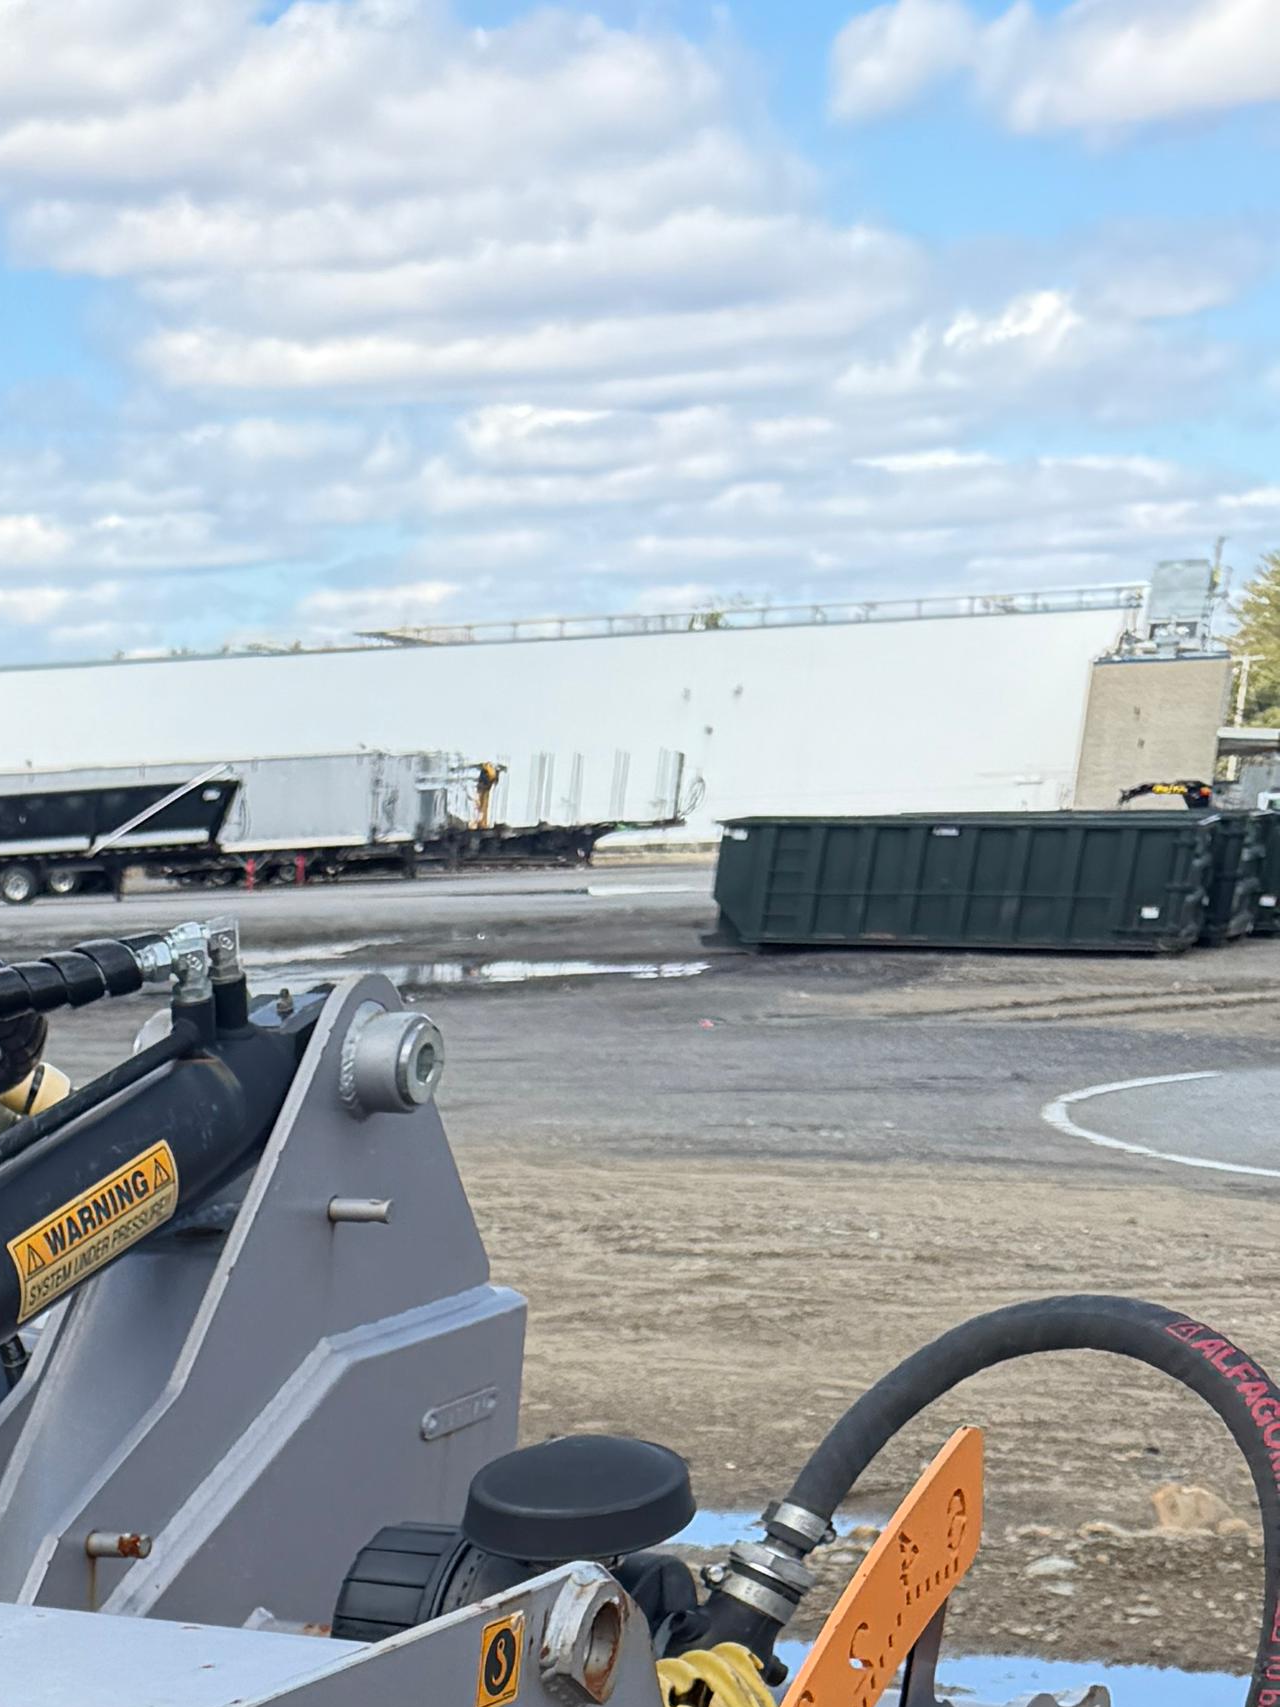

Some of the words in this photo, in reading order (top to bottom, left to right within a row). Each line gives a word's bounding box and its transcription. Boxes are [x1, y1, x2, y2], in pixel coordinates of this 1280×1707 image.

[43, 1169, 150, 1257] WARNING
[28, 1261, 72, 1307] SYSTEM
[73, 1235, 111, 1275] UNDER
